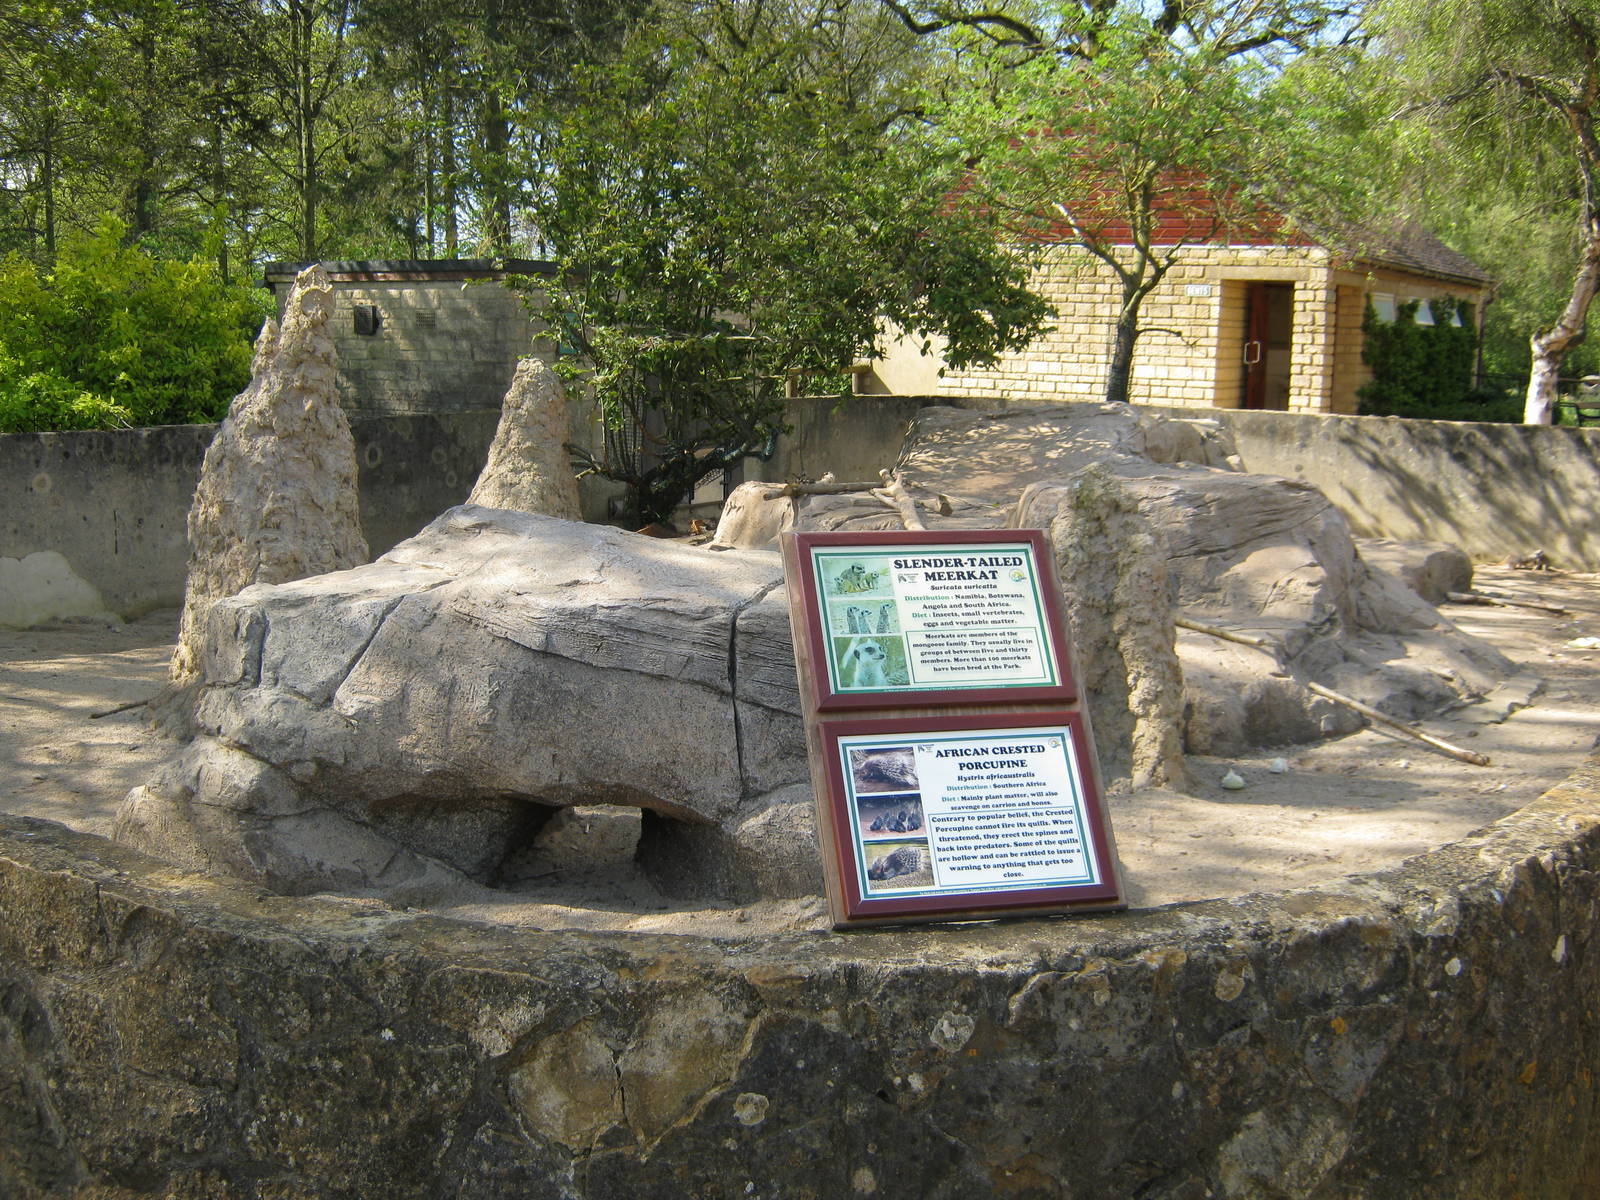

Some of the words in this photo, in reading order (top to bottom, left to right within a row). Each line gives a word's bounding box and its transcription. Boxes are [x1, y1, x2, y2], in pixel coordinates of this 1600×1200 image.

[894, 557, 1022, 568] SLENDER-TAILED
[924, 571, 998, 581] MEERKAT
[936, 747, 989, 758] AFRICAN
[992, 744, 1045, 755] CRESTED
[959, 760, 1027, 770] PORCUPINE
